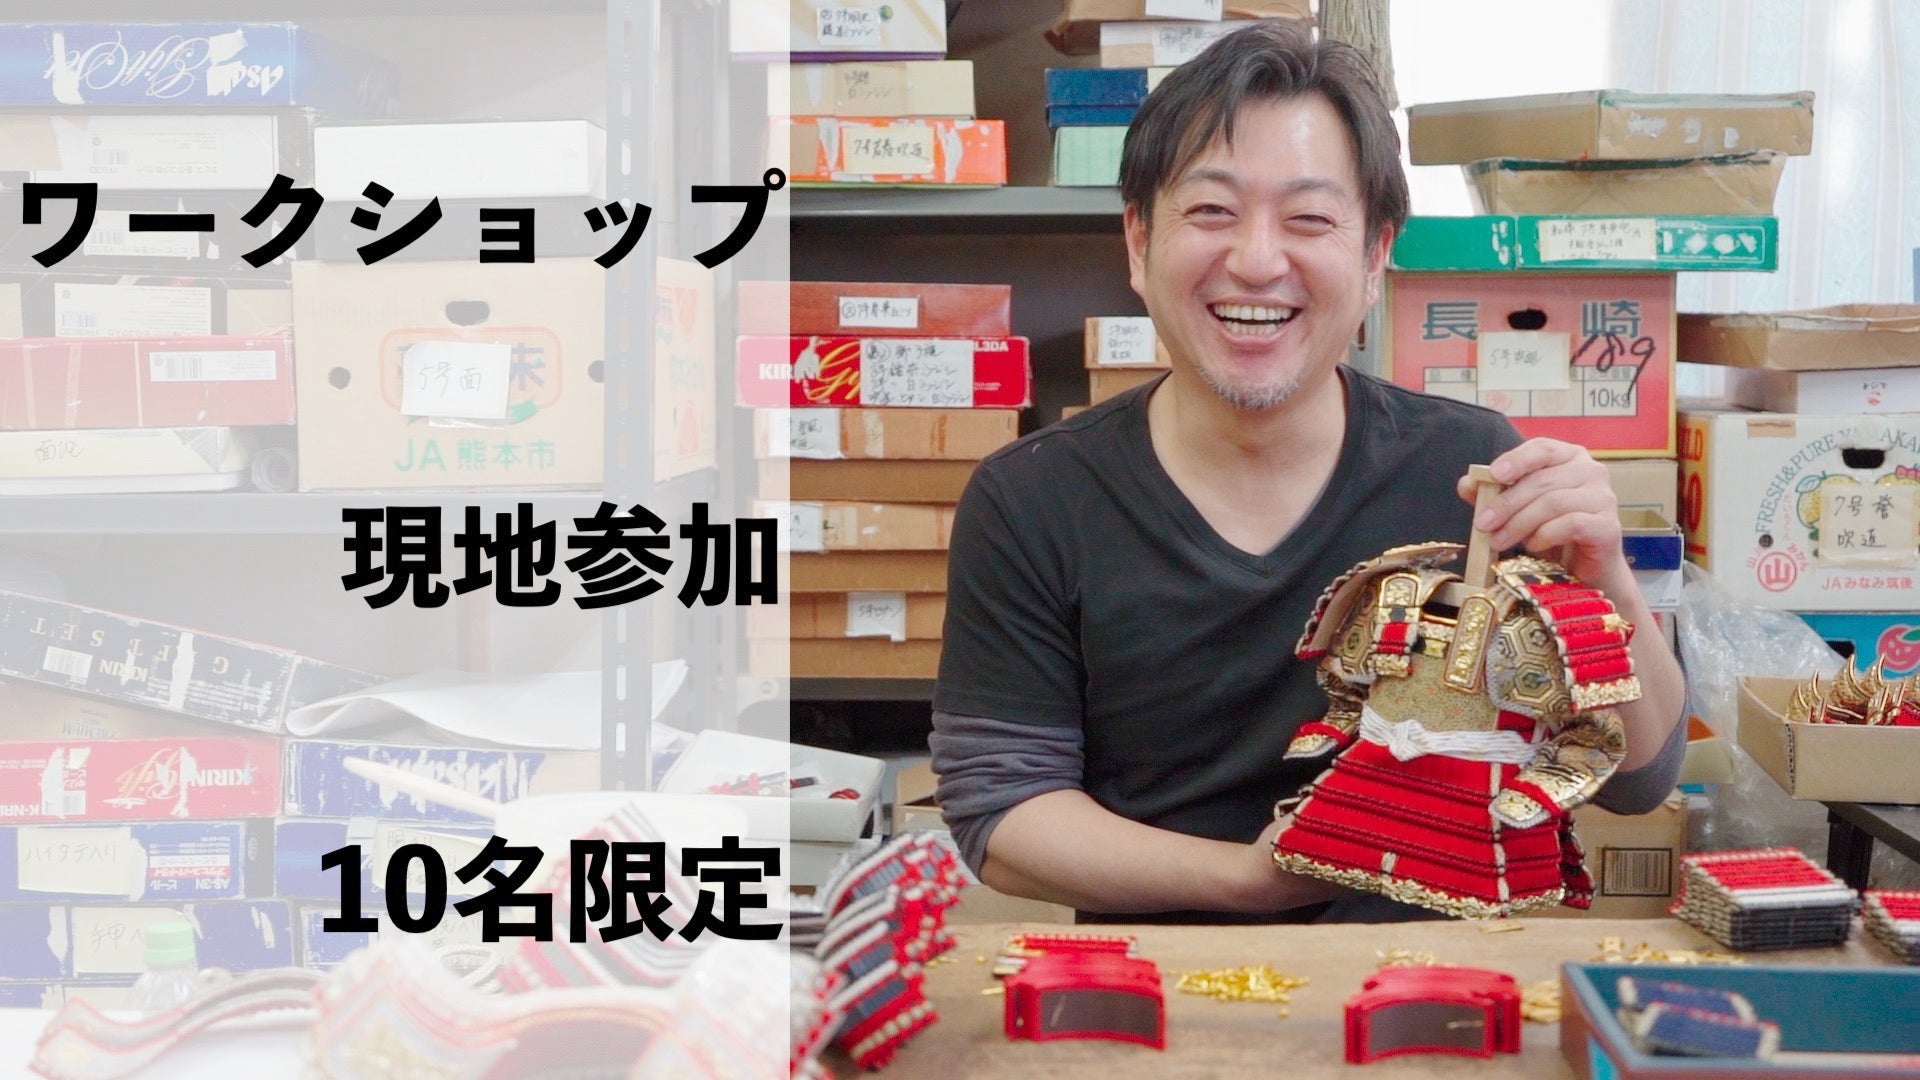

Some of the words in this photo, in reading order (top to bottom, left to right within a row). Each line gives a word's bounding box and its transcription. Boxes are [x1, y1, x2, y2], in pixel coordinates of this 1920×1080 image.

[1422, 301, 1642, 340] 長崎
[417, 360, 482, 398] 5号面
[1588, 387, 1632, 409] 10kg
[394, 439, 446, 472] JA
[456, 439, 556, 472] 熊本市
[29, 615, 106, 648] SET
[128, 637, 231, 675] GFT
[188, 767, 251, 787] KIRIN
